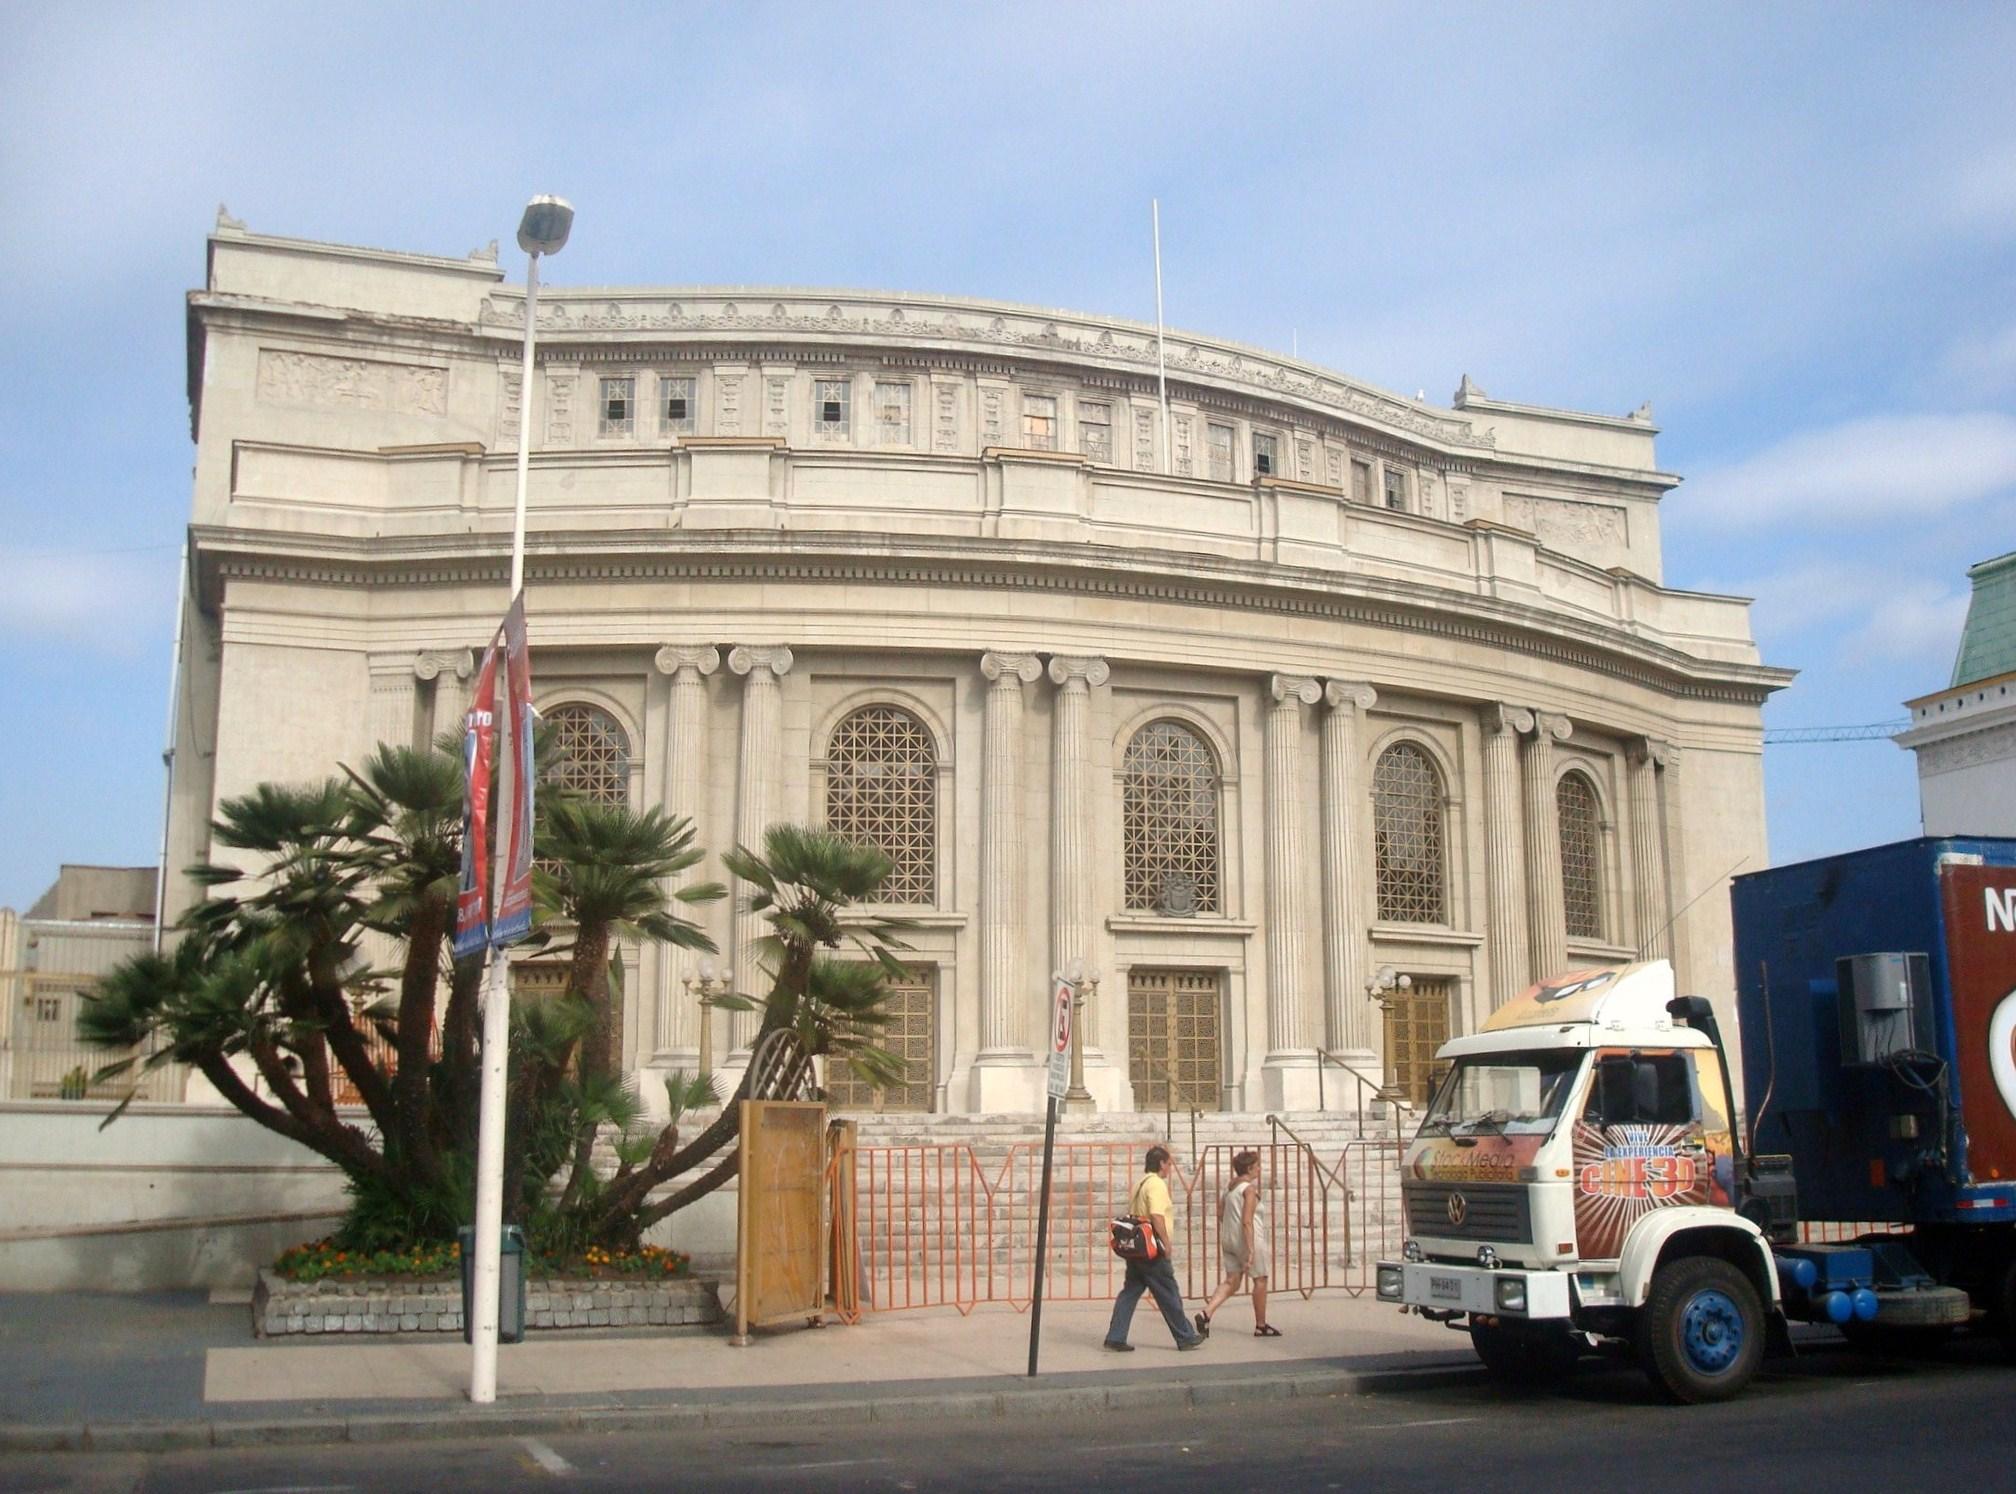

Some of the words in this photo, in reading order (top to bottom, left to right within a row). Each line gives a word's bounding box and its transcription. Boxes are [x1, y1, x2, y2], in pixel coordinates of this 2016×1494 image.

[1985, 887, 2016, 932] N
[1628, 1131, 1650, 1143] VIVE
[1617, 1145, 1675, 1158] EXPERIENCIA
[1580, 1157, 1649, 1199] CINE
[1650, 1156, 1696, 1199] 3D
